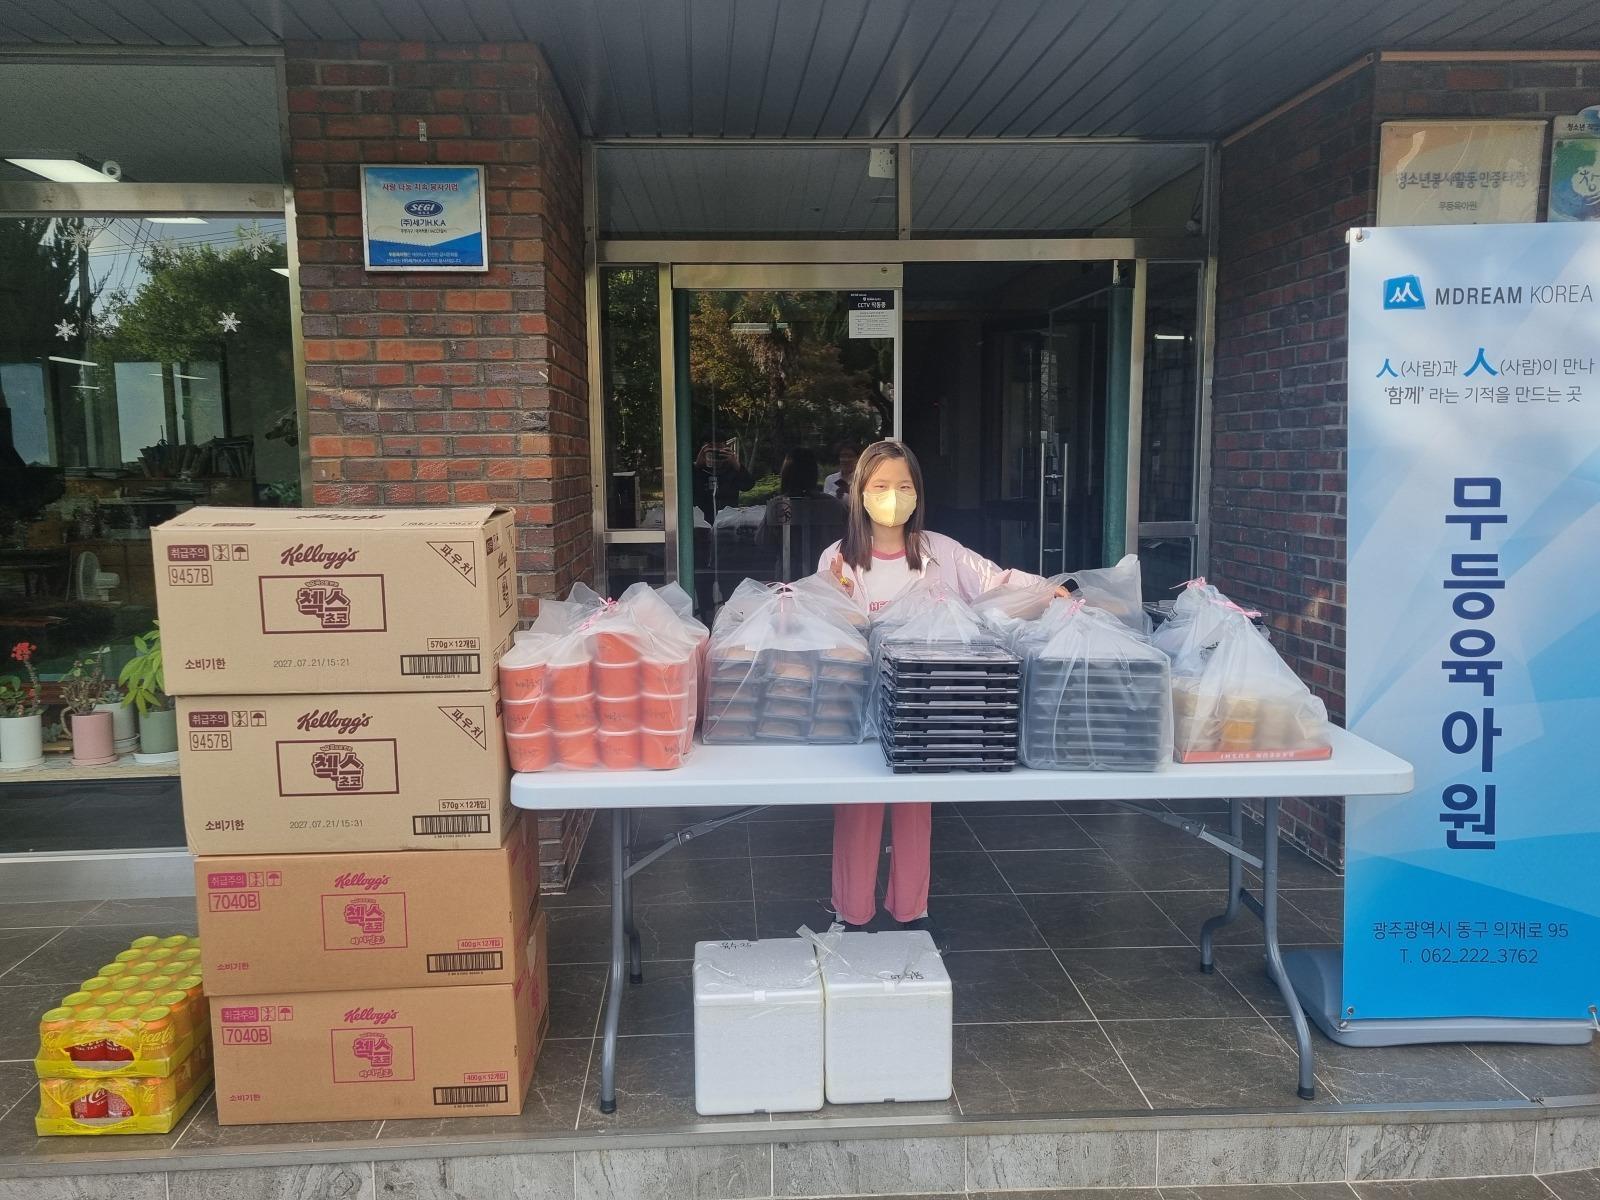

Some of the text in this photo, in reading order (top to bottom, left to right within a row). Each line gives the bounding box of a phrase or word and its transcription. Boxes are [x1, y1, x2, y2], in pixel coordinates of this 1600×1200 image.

[382, 183, 396, 191] 사랑
[411, 203, 435, 211] SEGI
[1435, 284, 1593, 305] MDREAM KOREA
[871, 301, 886, 309] 작동중
[1563, 358, 1595, 375] 만나
[1429, 387, 1459, 404] 라는
[1464, 386, 1510, 404] 기적을
[1515, 386, 1562, 403] 만드는
[1567, 386, 1582, 403] 곳
[171, 547, 207, 559] 취급주의
[280, 543, 360, 570] Kellogg's
[439, 543, 475, 577] 파우치
[171, 568, 210, 584] 9457B
[298, 589, 349, 613] 첵스
[324, 613, 348, 624] 초코
[185, 658, 226, 670] 소비기한
[1439, 477, 1508, 850] 무등육아원
[191, 713, 227, 725] 취급주의
[297, 709, 373, 735] Kellogg's
[451, 708, 484, 740] 파우치
[191, 733, 230, 749] 9457B
[314, 754, 362, 776] 첵스
[339, 776, 361, 787] 초코
[205, 818, 245, 831] 소비기한
[211, 874, 244, 887] 취급주의
[334, 872, 391, 890] Kellogg's
[213, 894, 257, 910] 7040B
[346, 906, 383, 922] 첵스
[1372, 921, 1568, 940] 광주광역시 동구 의재로 95
[1400, 949, 1538, 964] T. 062_222_3762
[216, 961, 250, 971] 소비기한
[344, 1008, 398, 1025] Kellogg's
[226, 1028, 268, 1043] 7040B
[355, 1040, 391, 1056] 첵스
[229, 1093, 261, 1102] 소비기한
